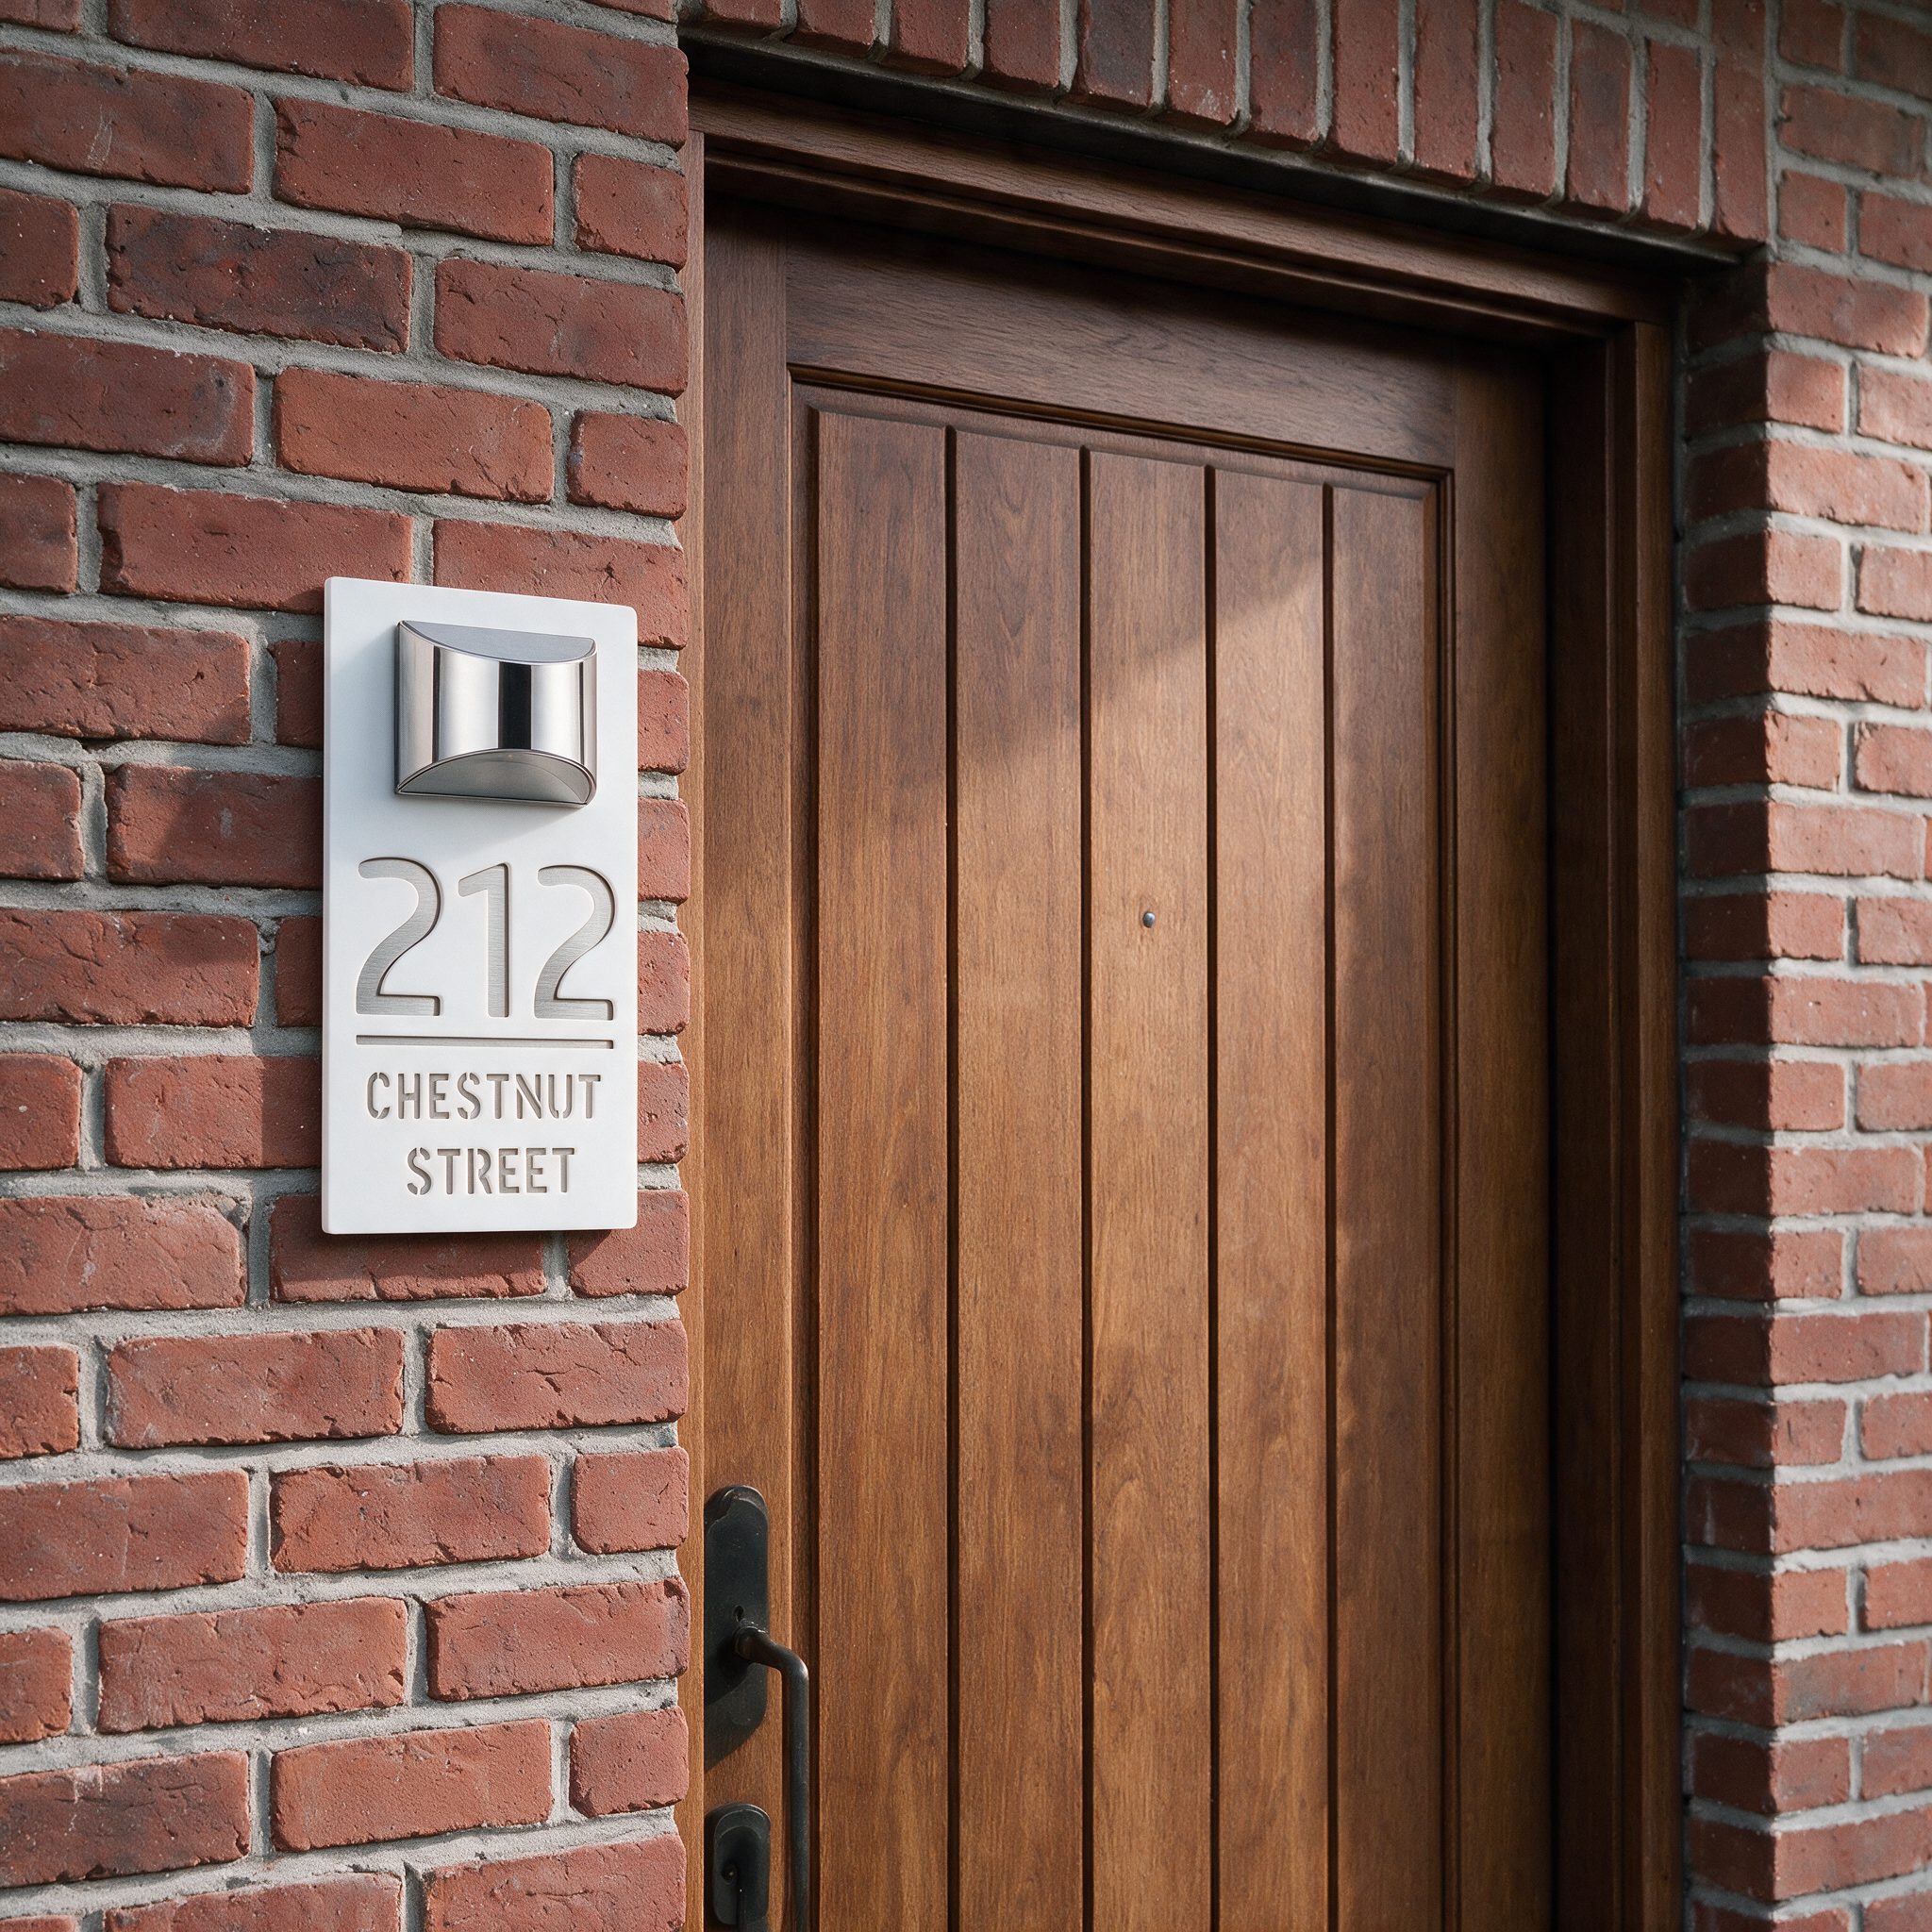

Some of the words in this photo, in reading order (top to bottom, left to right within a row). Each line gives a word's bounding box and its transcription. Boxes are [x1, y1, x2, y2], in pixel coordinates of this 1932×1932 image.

[356, 857, 615, 1021] 212
[366, 1072, 601, 1120] CHESTNUT
[406, 1146, 575, 1195] STREET
